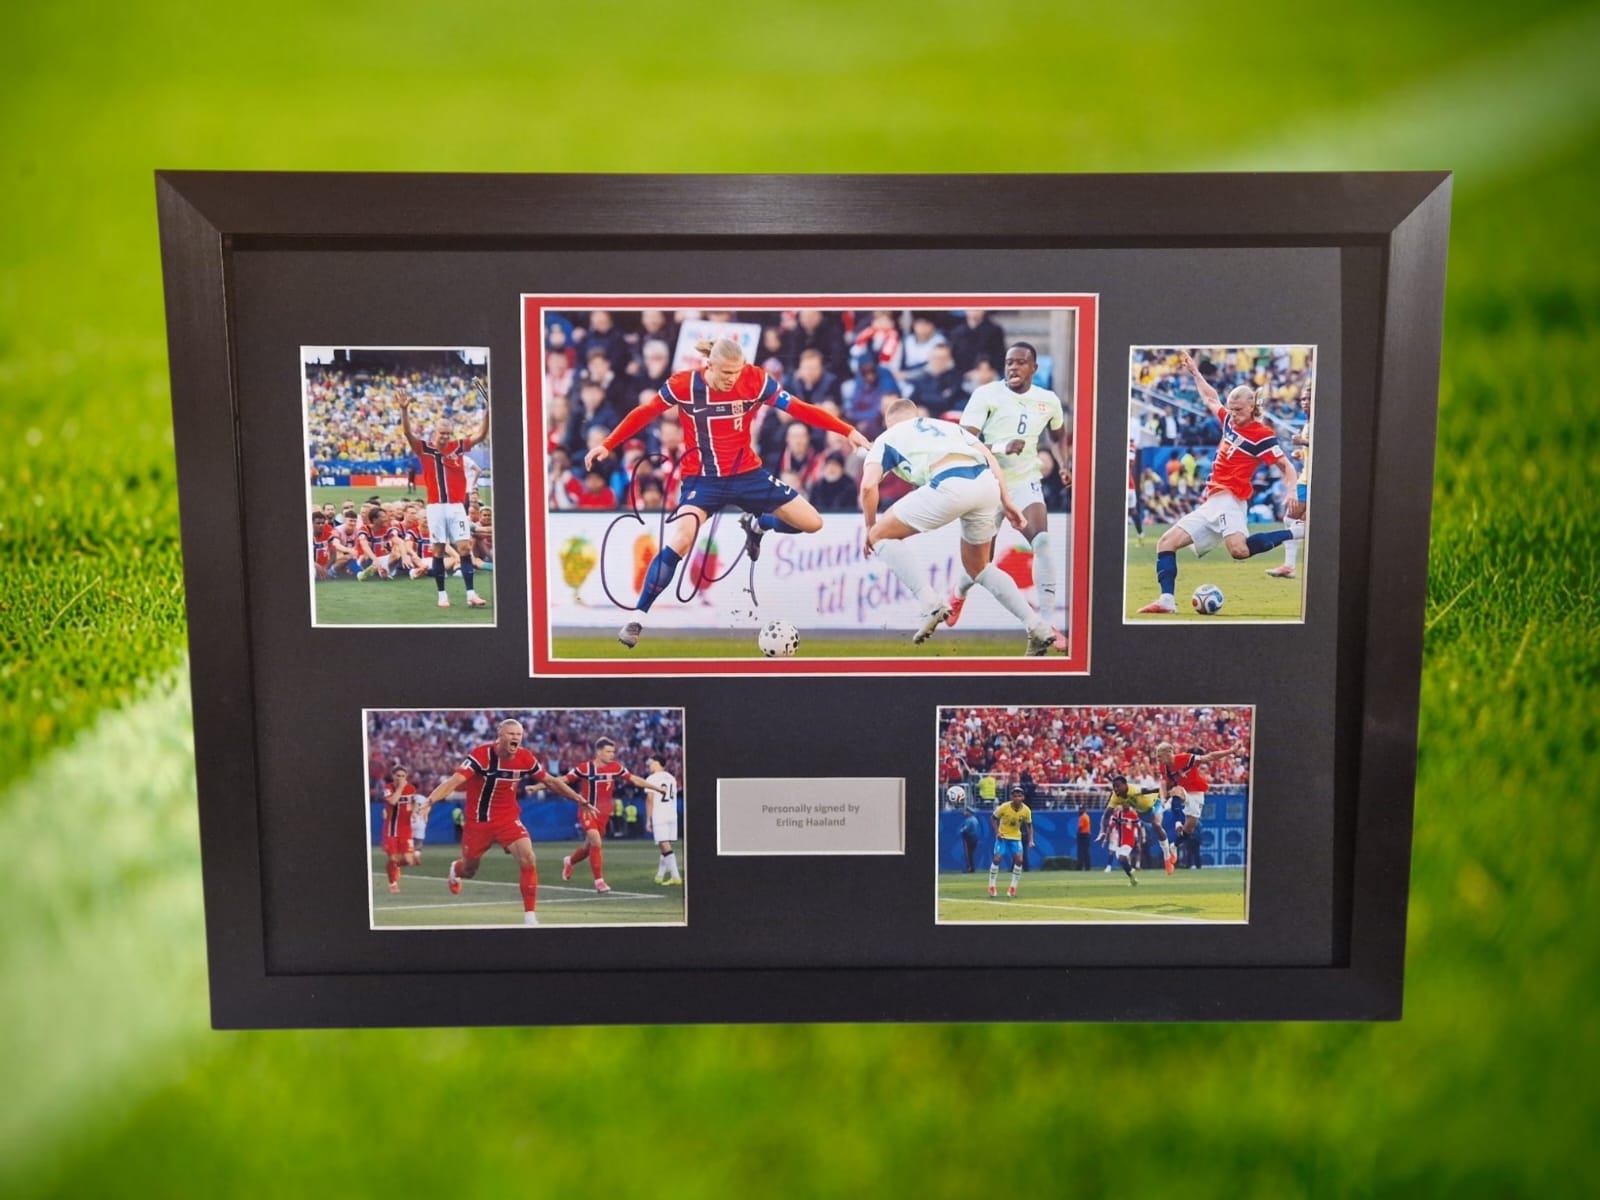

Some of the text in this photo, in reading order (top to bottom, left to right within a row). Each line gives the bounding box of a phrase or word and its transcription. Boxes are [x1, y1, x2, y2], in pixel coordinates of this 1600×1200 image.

[1017, 413, 1028, 435] 6
[762, 803, 860, 815] Personally signed by
[776, 817, 846, 829] Erling Haaland
